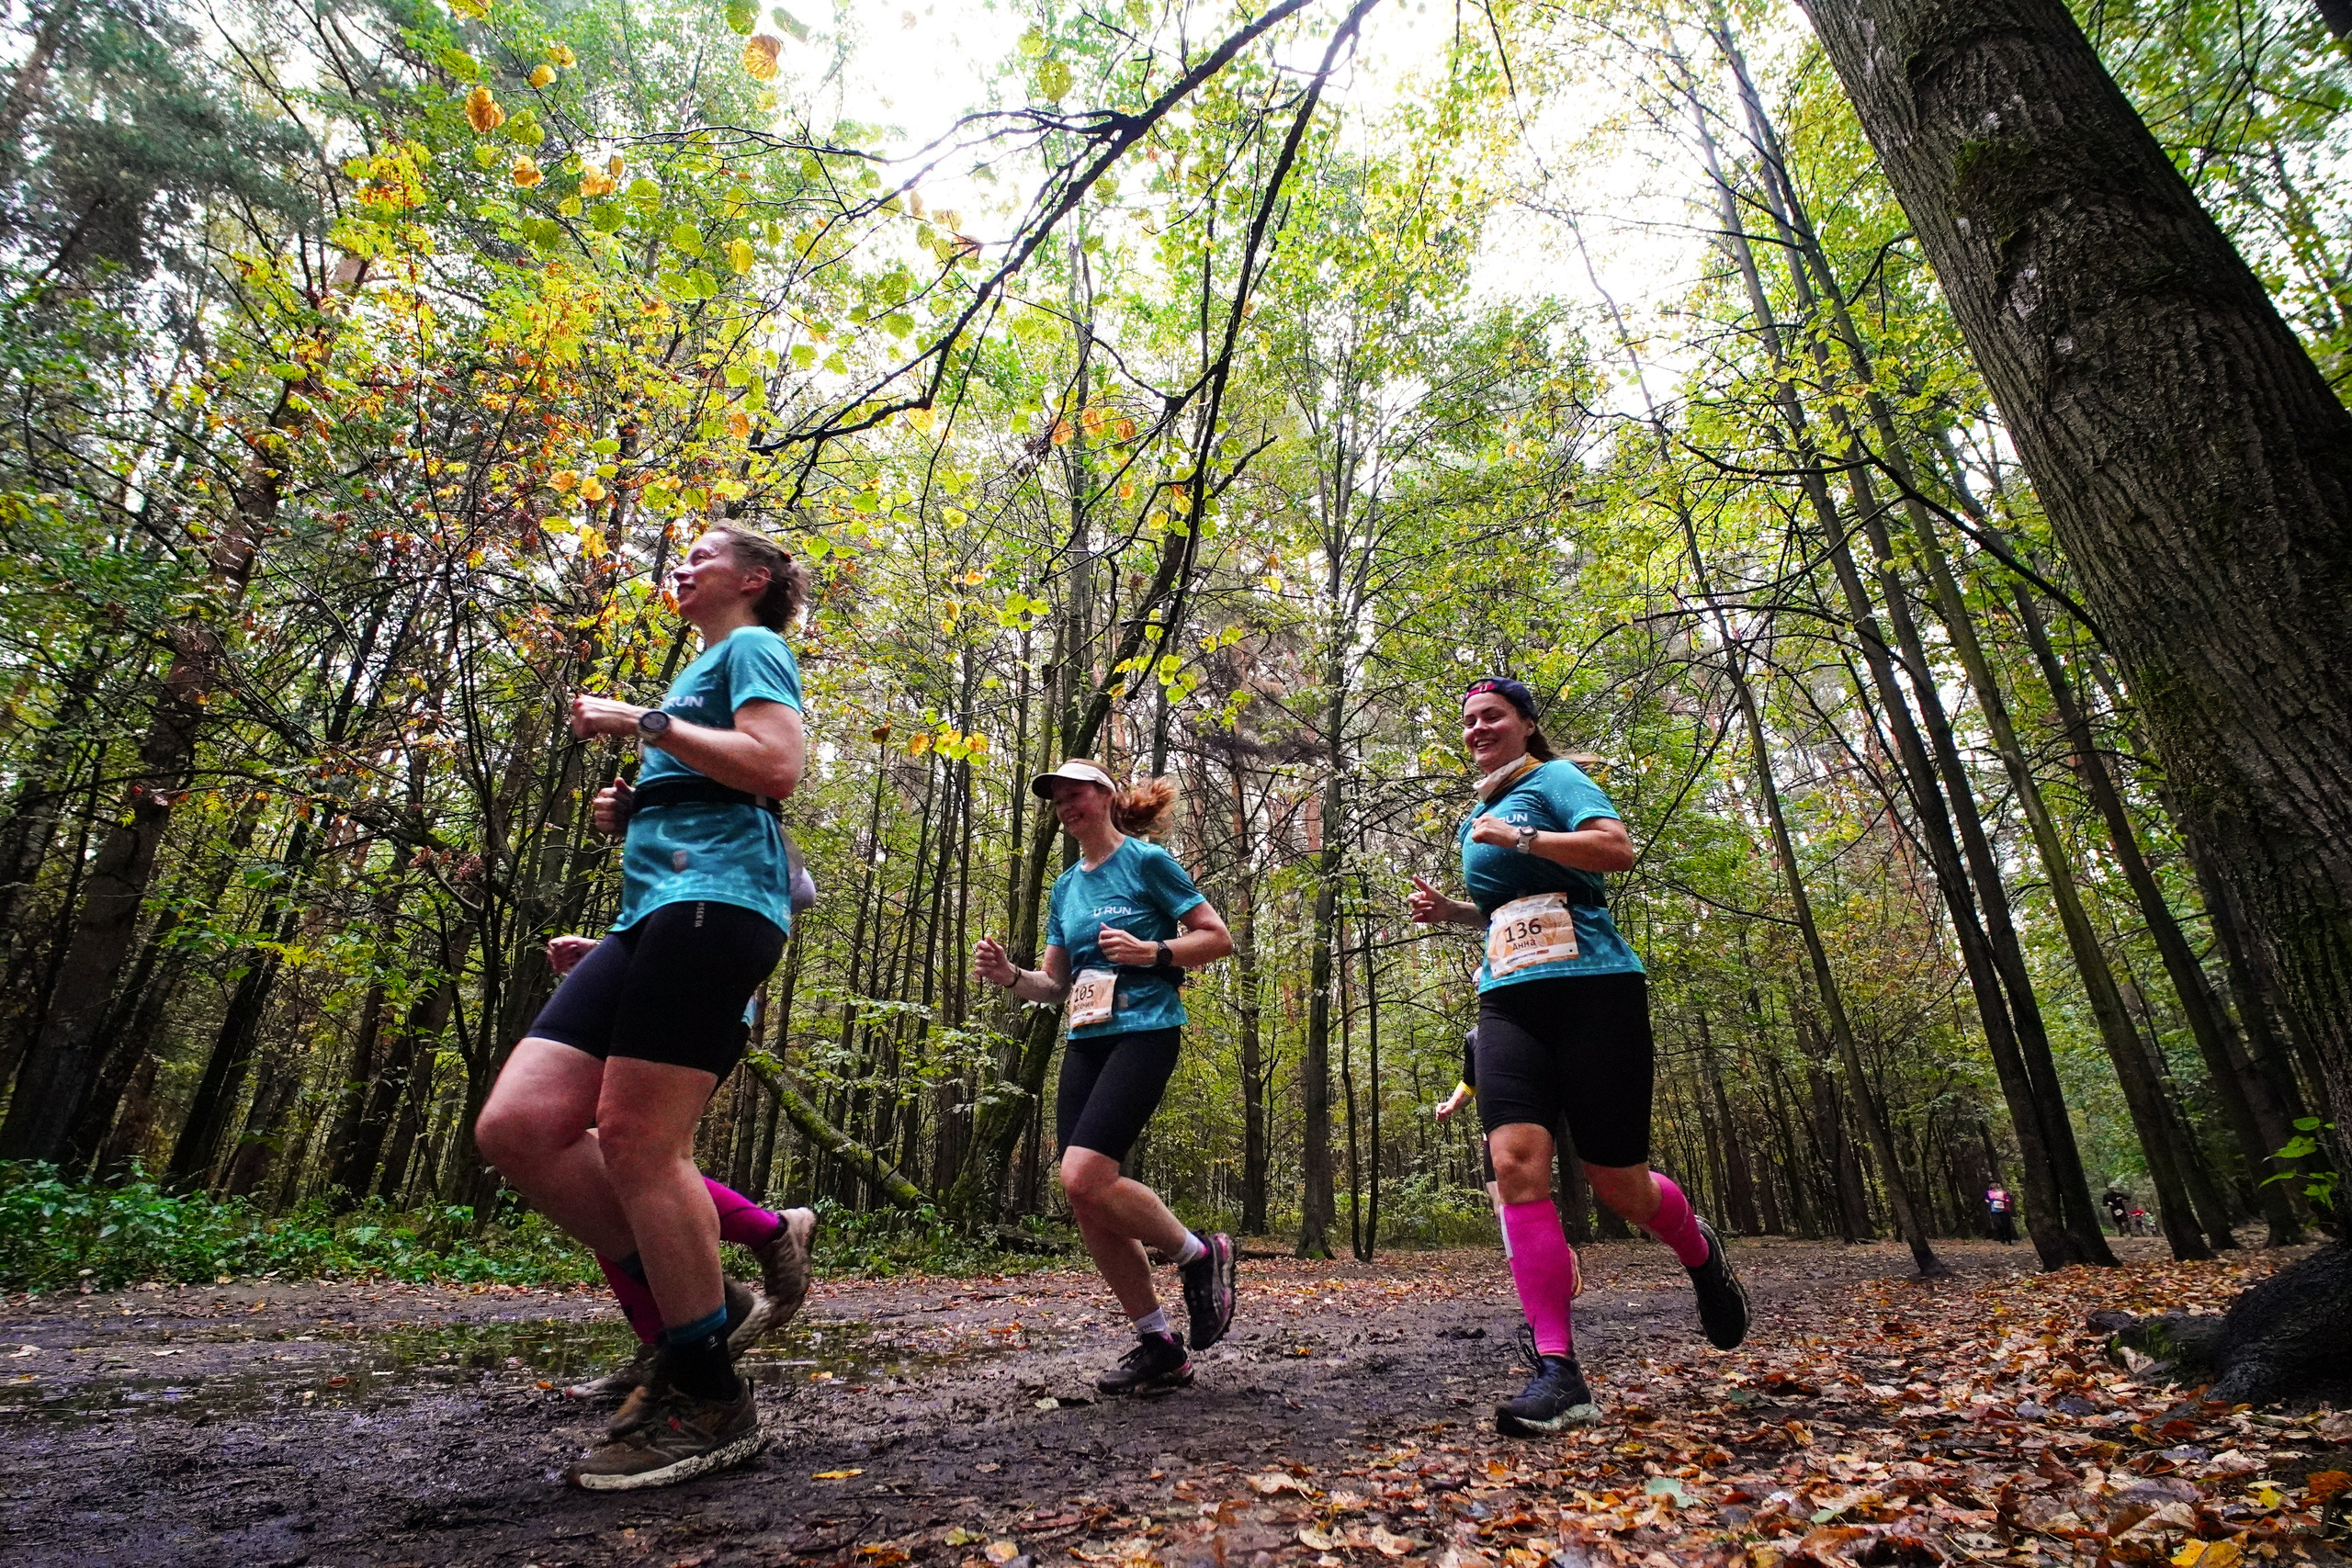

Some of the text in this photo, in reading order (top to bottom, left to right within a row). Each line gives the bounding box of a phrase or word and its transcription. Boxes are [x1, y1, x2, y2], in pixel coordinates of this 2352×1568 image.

[1505, 919, 1542, 942] 136
[1512, 938, 1537, 952] Анна
[1074, 984, 1094, 1002] 105
